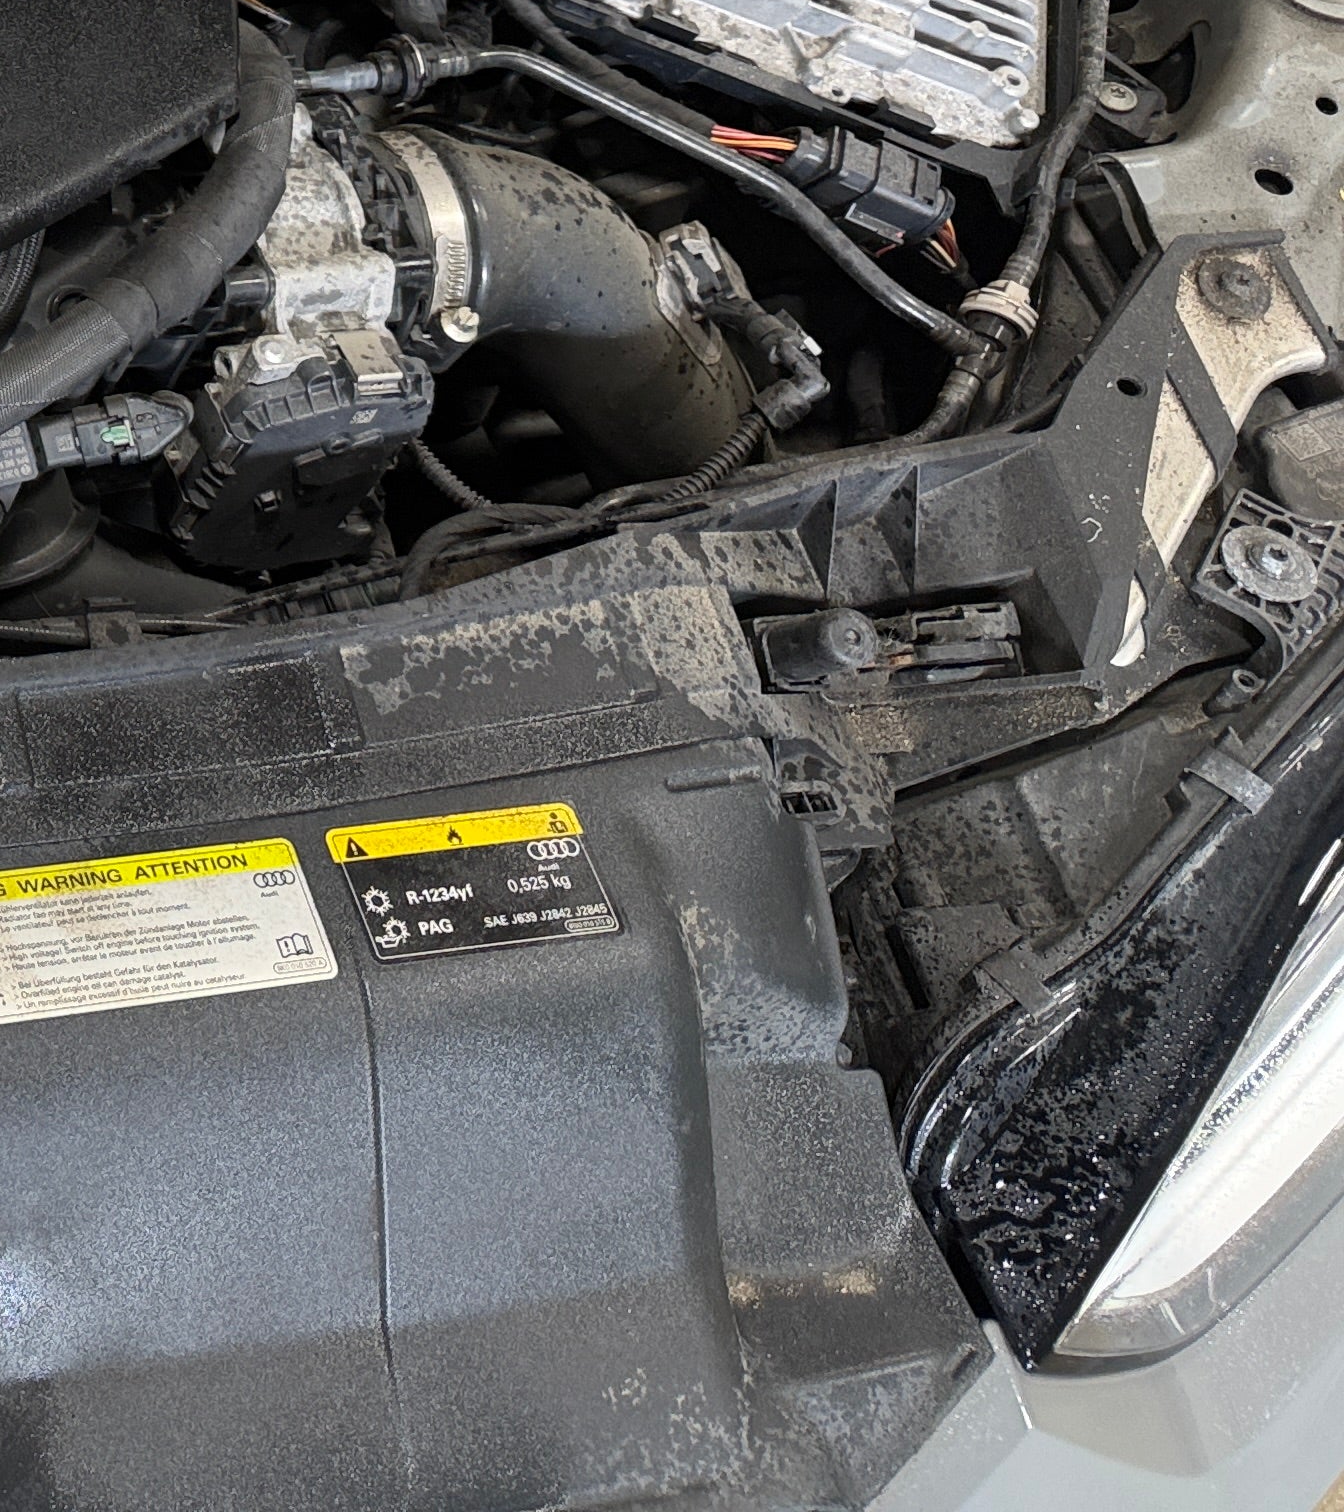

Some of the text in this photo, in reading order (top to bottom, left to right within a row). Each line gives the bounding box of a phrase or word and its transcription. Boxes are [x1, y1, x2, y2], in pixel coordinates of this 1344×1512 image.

[17, 869, 122, 894] WARNING
[134, 852, 248, 879] ATTENTION
[506, 872, 572, 895] 0,525 kg
[406, 884, 476, 905] R-1234yf
[48, 910, 65, 918] may
[484, 917, 509, 929] SAE
[510, 911, 538, 925] J639
[539, 906, 571, 921] J2842
[186, 920, 210, 928] Motor
[418, 919, 454, 936] PAG
[9, 953, 28, 961] High
[64, 945, 91, 954] Switch
[93, 942, 104, 950] off
[107, 940, 133, 949] engine
[134, 936, 161, 945] before
[162, 932, 197, 941] touching
[198, 928, 228, 938] ignition
[109, 949, 137, 958] moteur
[174, 940, 204, 949] toucher
[143, 965, 154, 973] für
[156, 963, 172, 971] den
[62, 985, 89, 994] engine
